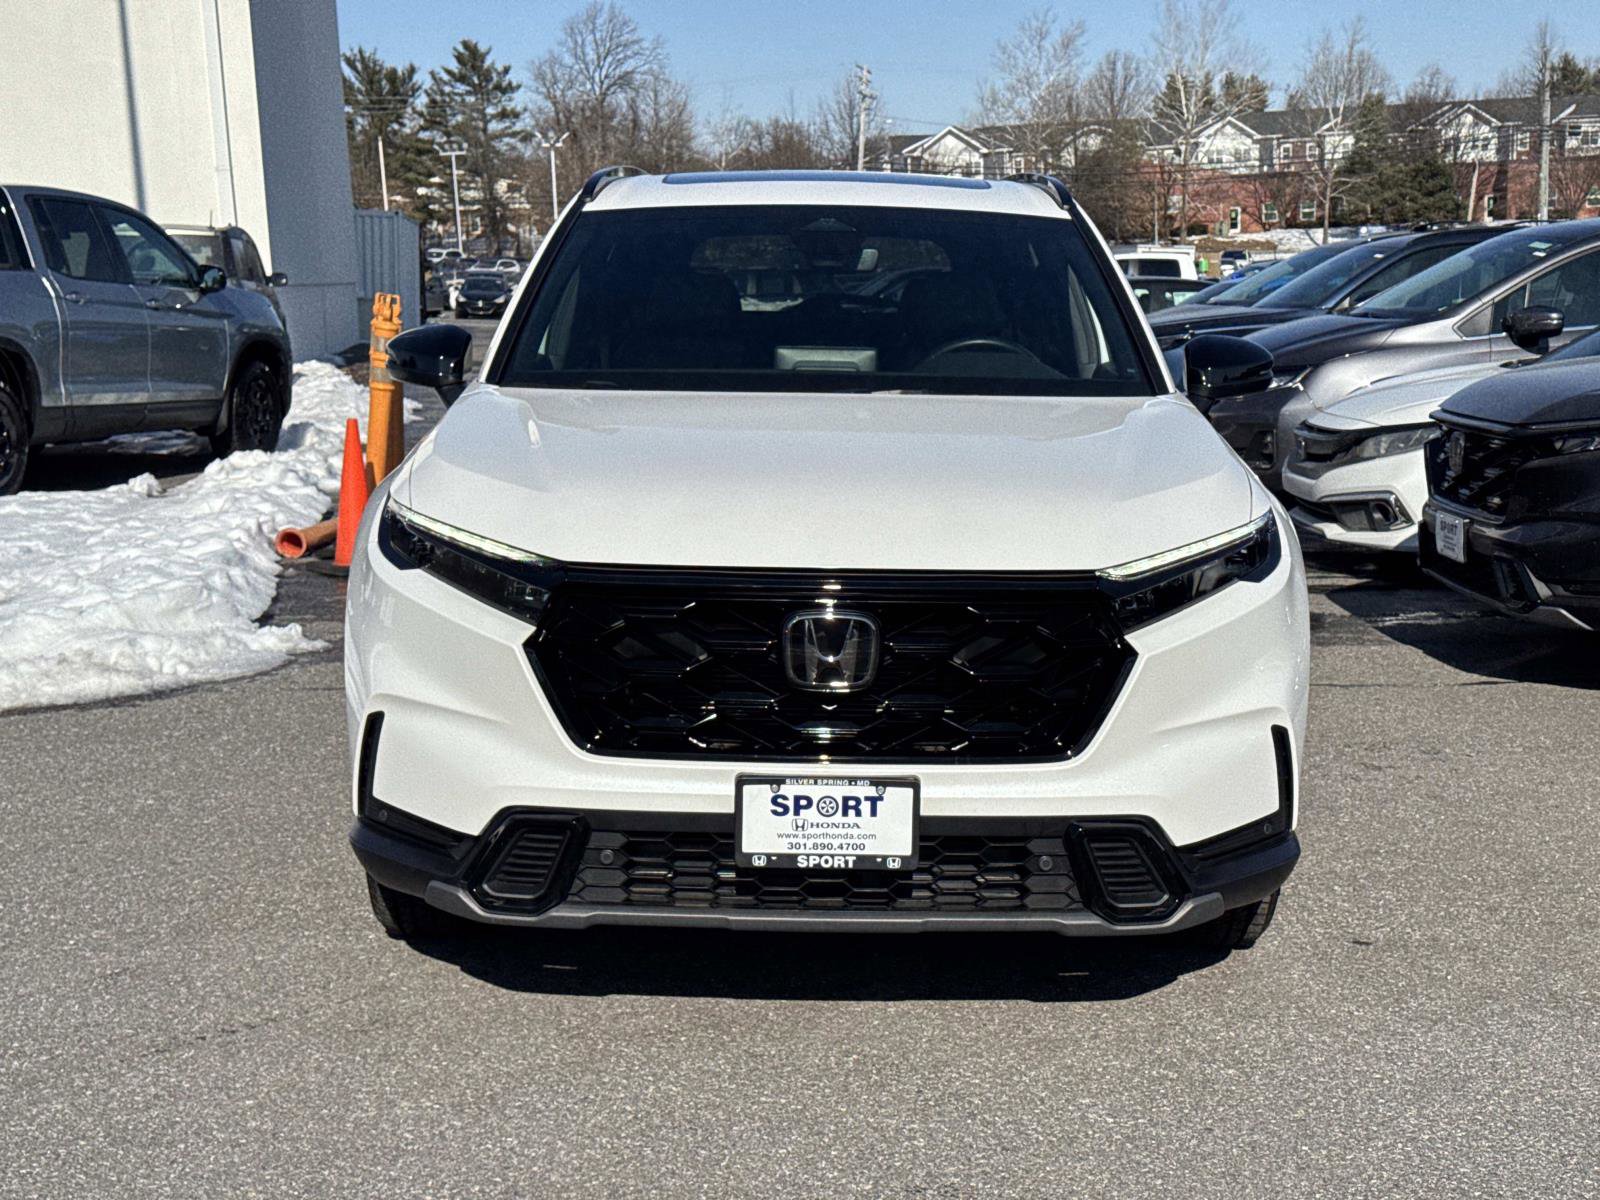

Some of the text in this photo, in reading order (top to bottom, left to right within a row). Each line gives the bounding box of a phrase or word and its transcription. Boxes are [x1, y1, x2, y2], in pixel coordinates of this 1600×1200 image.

[770, 794, 884, 818] SPORT
[809, 821, 862, 829] HONDA
[776, 832, 877, 840] www.sporthonda.com
[787, 842, 866, 851] 301.890.4700
[796, 855, 857, 868] SPORT
